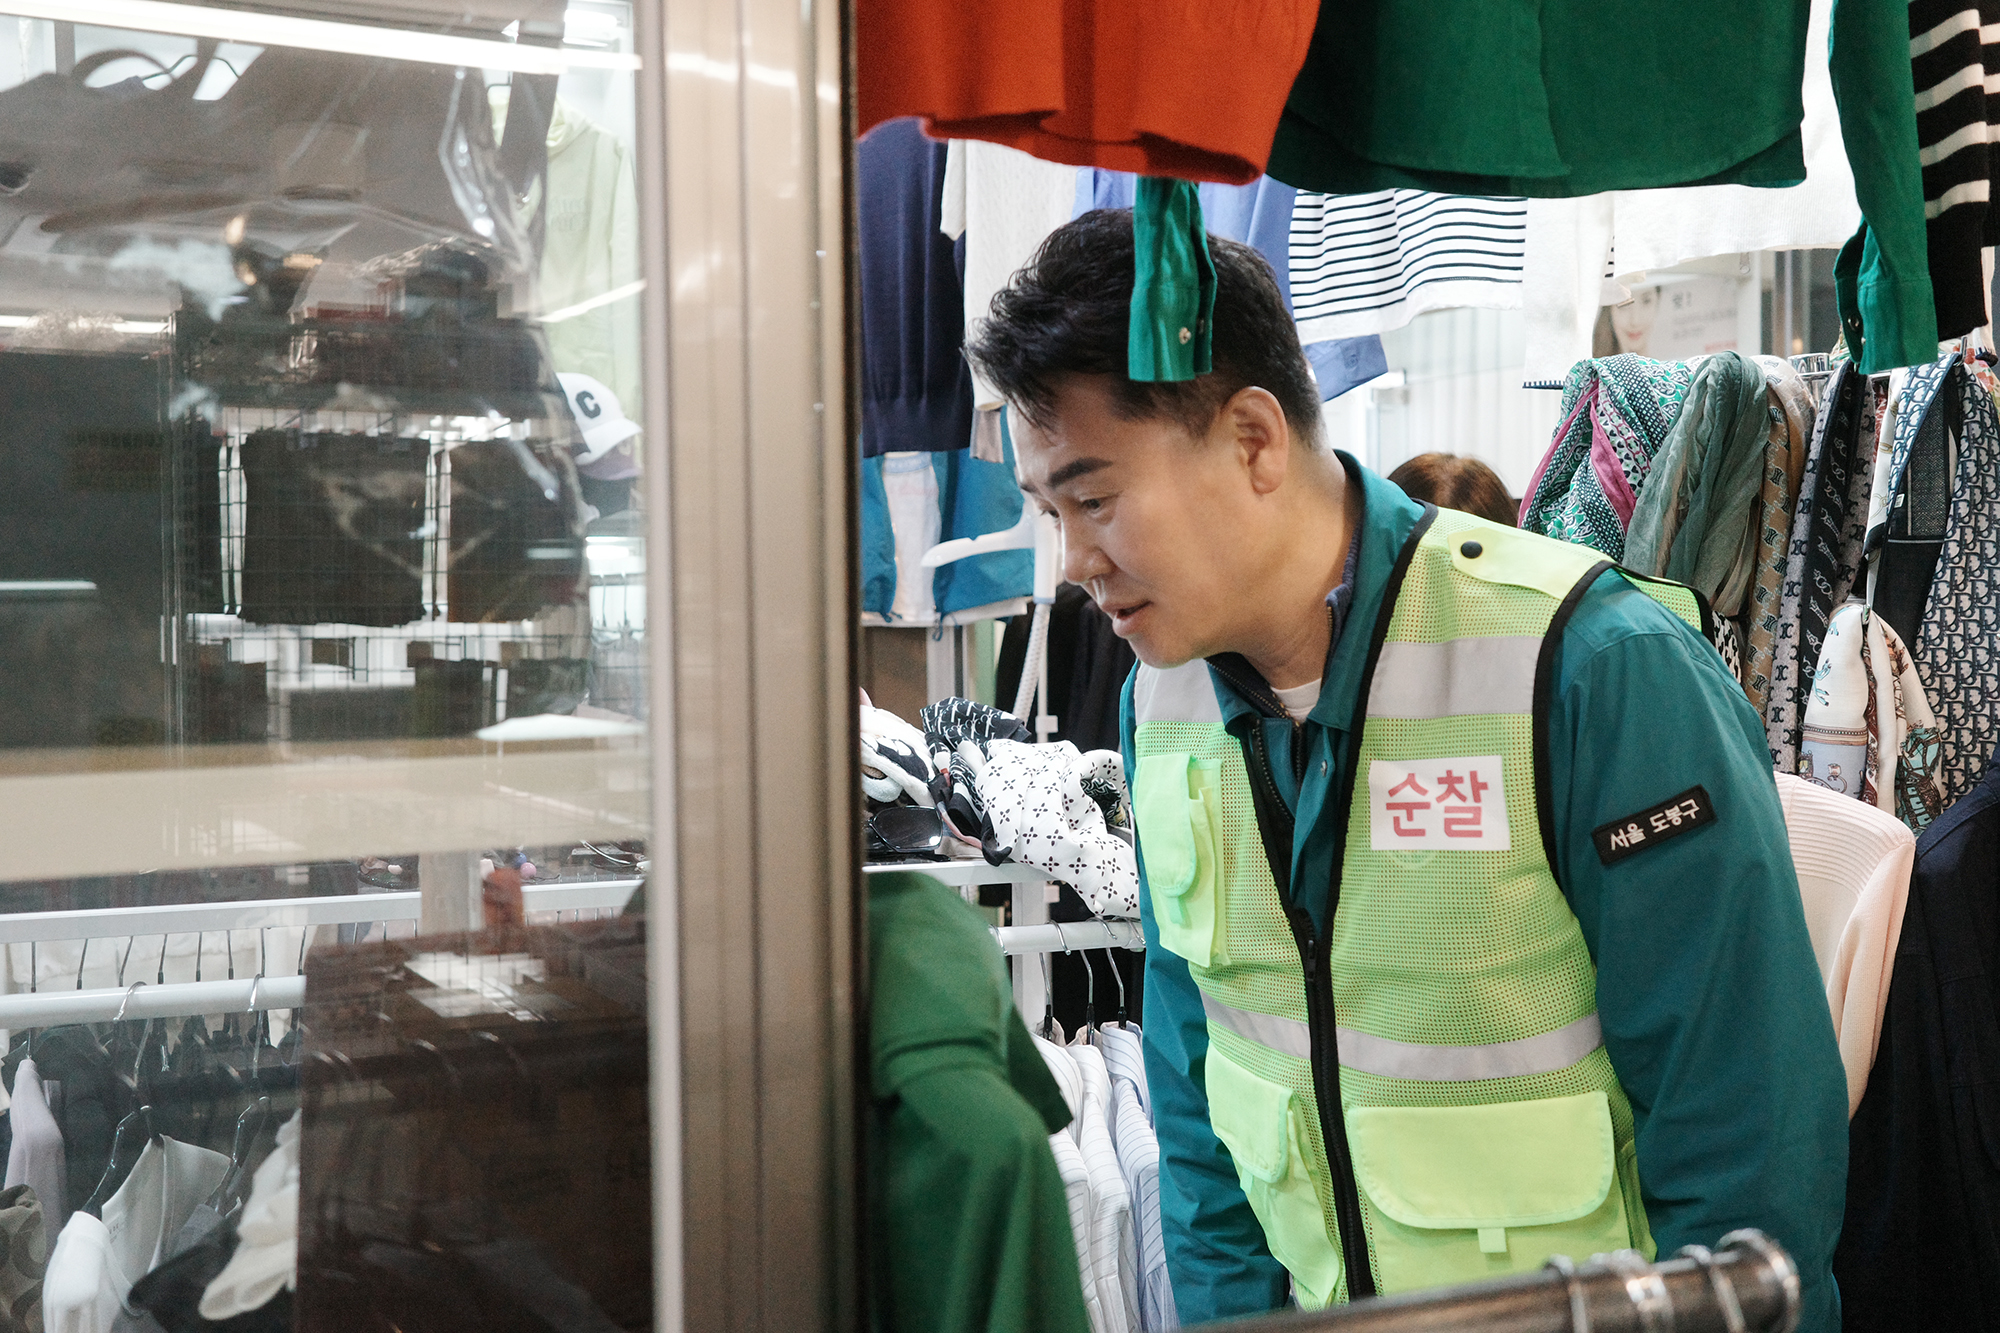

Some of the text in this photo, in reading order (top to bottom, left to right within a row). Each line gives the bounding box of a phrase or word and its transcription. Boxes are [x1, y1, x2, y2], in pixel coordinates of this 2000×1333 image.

[575, 390, 601, 419] C
[1385, 769, 1489, 838] 순찰
[1610, 798, 1700, 851] 서울 도봉구
